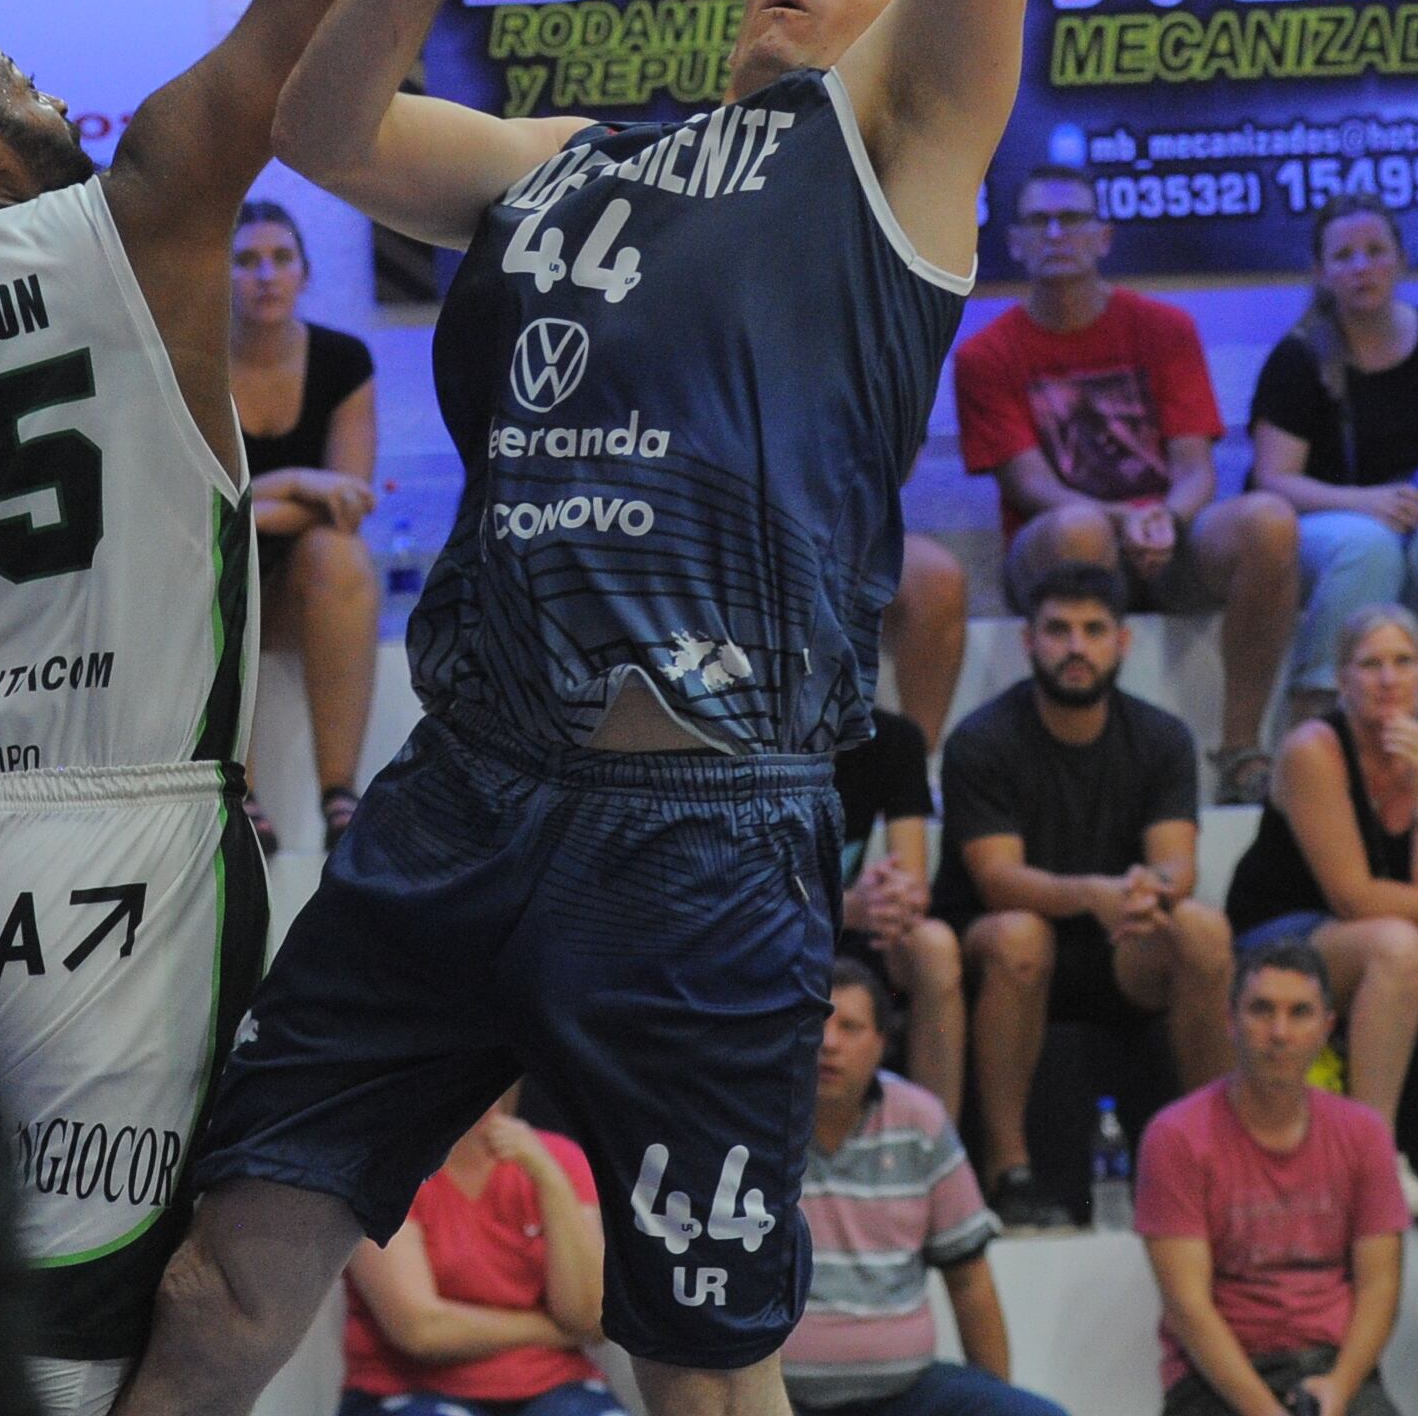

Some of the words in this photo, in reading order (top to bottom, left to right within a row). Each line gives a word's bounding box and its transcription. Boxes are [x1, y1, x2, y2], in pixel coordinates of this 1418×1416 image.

[501, 197, 642, 304] 44
[631, 1142, 777, 1255] 44
[672, 1266, 729, 1308] UR
